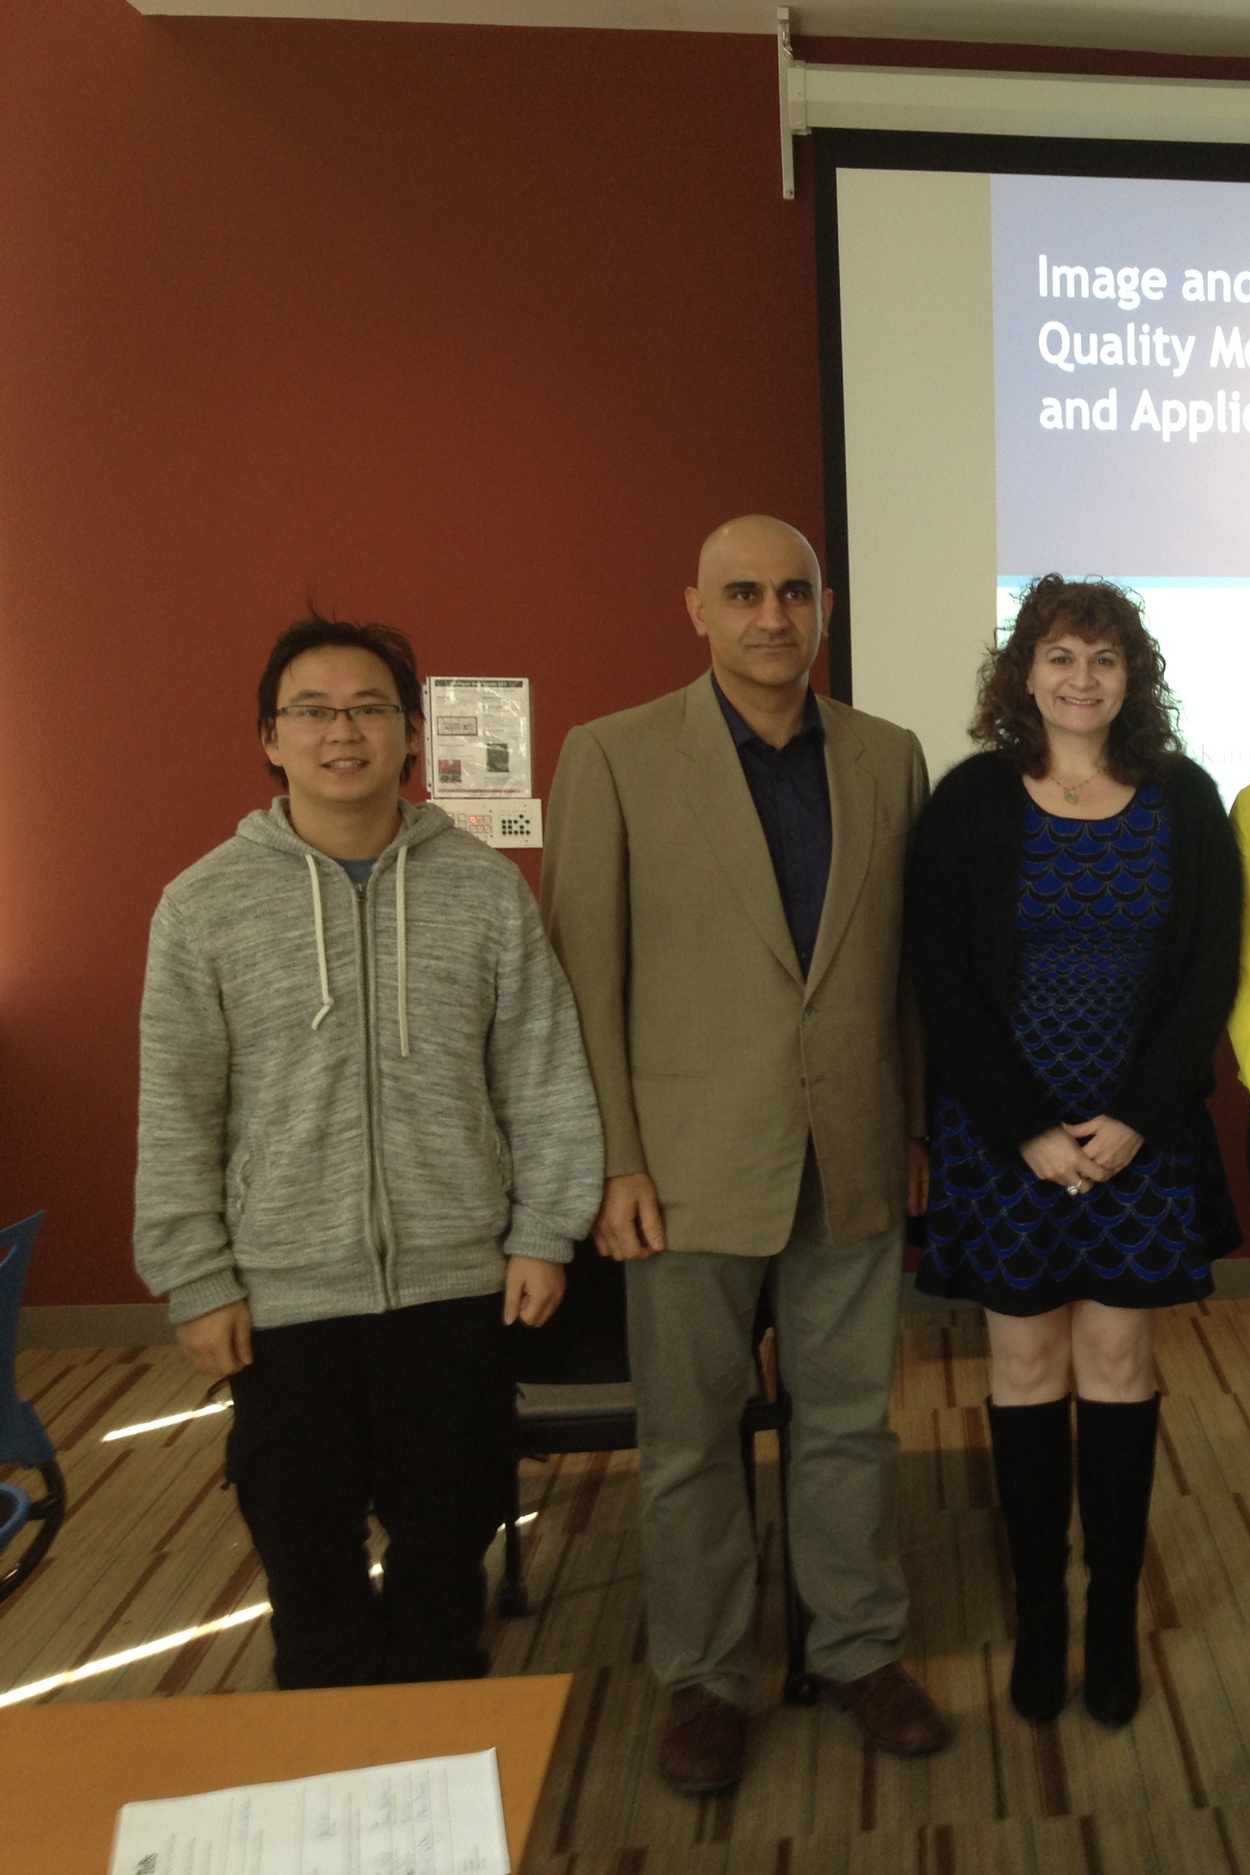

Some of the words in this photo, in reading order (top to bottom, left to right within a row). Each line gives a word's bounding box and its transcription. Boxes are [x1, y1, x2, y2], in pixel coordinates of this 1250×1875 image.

[1038, 254, 1168, 311] Image
[1037, 320, 1196, 378] Quality
[1038, 386, 1118, 431] and
